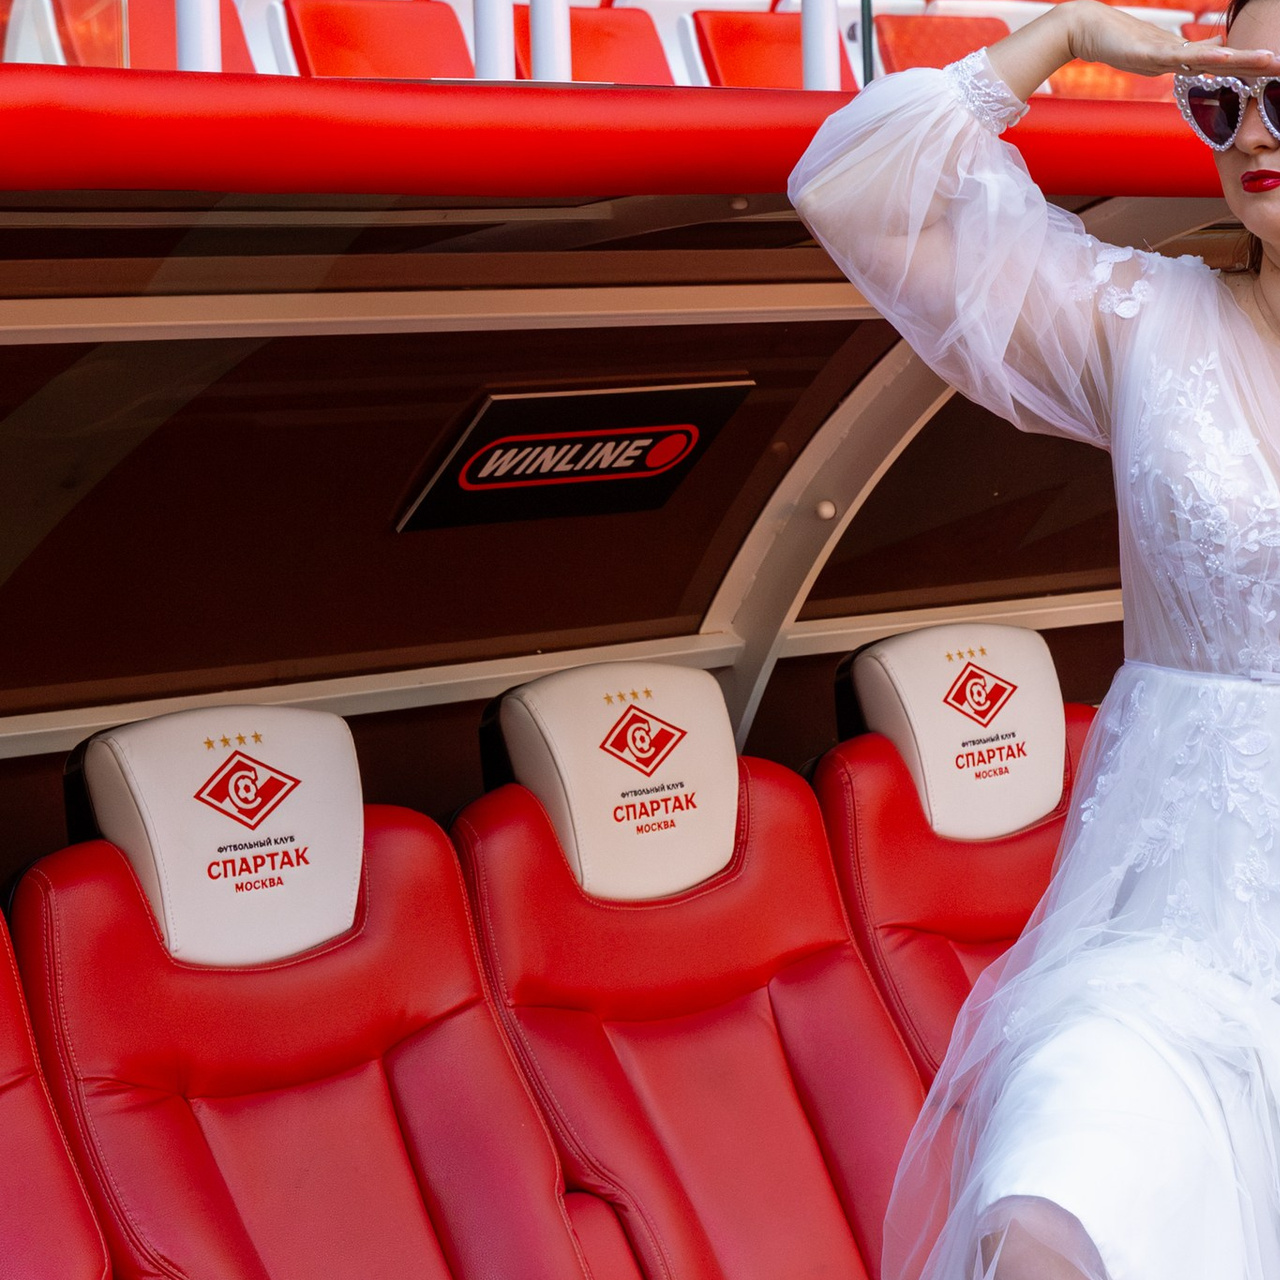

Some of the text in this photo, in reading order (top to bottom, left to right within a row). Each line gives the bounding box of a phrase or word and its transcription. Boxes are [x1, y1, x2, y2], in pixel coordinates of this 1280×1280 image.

[477, 438, 654, 478] WINLINE
[955, 741, 1027, 769] СПАРТАК
[975, 766, 1009, 780] МОСКВА
[621, 782, 684, 798] ФУТБОЛЬНЫЙ КЛУБ
[613, 792, 697, 823] СПАРТАК
[636, 820, 676, 834] МОСКВА
[217, 835, 295, 853] ФУТБОЛЬНЫЙ КЛУБ
[207, 846, 310, 880] СПАРТАК
[235, 876, 284, 893] МОСКВА
